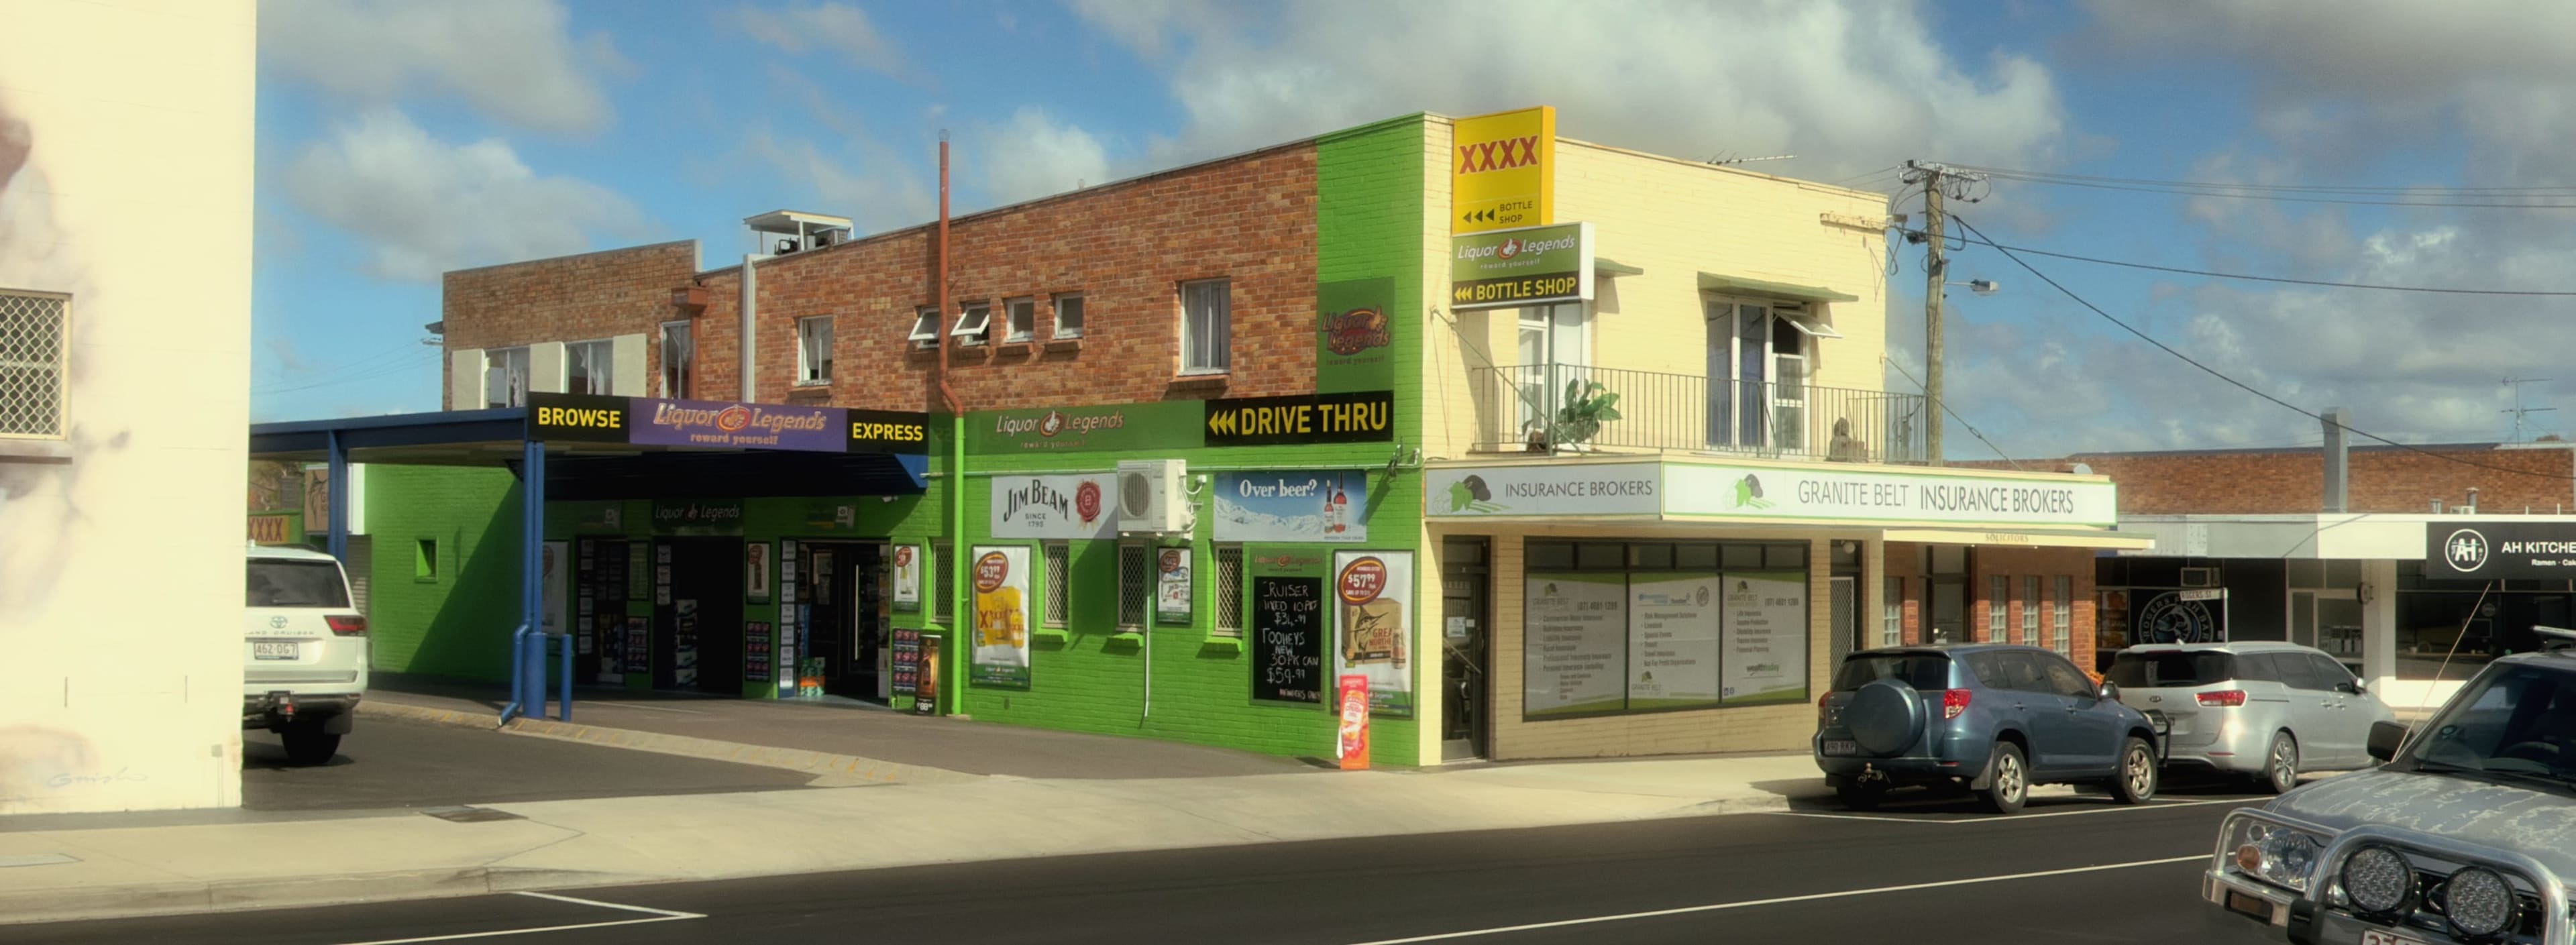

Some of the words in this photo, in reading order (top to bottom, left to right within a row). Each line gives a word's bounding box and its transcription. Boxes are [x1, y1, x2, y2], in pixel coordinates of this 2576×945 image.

[1459, 135, 1538, 174] XXXX
[1500, 201, 1533, 212] BOTTLE
[1499, 214, 1523, 224] SHOP
[1458, 245, 1497, 262] Liquor
[1521, 235, 1575, 255] Legends
[1477, 280, 1532, 300] BOTTLE
[1535, 277, 1576, 296] SHOP
[538, 407, 621, 428] BROWSE
[653, 402, 718, 430] Liquor
[751, 408, 827, 433] Legends
[996, 414, 1039, 437] Liquor
[1065, 410, 1124, 435] Legends
[1242, 405, 1311, 435] DRIVE
[1318, 402, 1387, 433] THRU
[690, 433, 729, 443] reward
[733, 434, 779, 445] yourself
[852, 423, 924, 441] EXPRESS
[1240, 479, 1276, 498] Over
[1279, 478, 1318, 497] beer?
[1505, 481, 1585, 498] INSURANCE
[1589, 480, 1653, 497] BROKERS
[1798, 480, 1868, 506] GRANITE
[1874, 483, 1909, 507] BELT
[1921, 484, 2008, 512] INSURANCE
[2012, 488, 2074, 514] BROKERS
[1004, 486, 1028, 522] JIM
[1032, 479, 1069, 522] BEAM
[655, 504, 684, 522] Liquor
[700, 504, 740, 522] Legends
[248, 518, 283, 542] XXXX
[1985, 533, 2029, 543] SOLICITORS
[2502, 541, 2522, 553] AH
[1262, 628, 1305, 646] TOOHEYS
[1373, 628, 1392, 638] GREA
[1275, 645, 1293, 656] NEW
[1302, 657, 1320, 666] CAN
